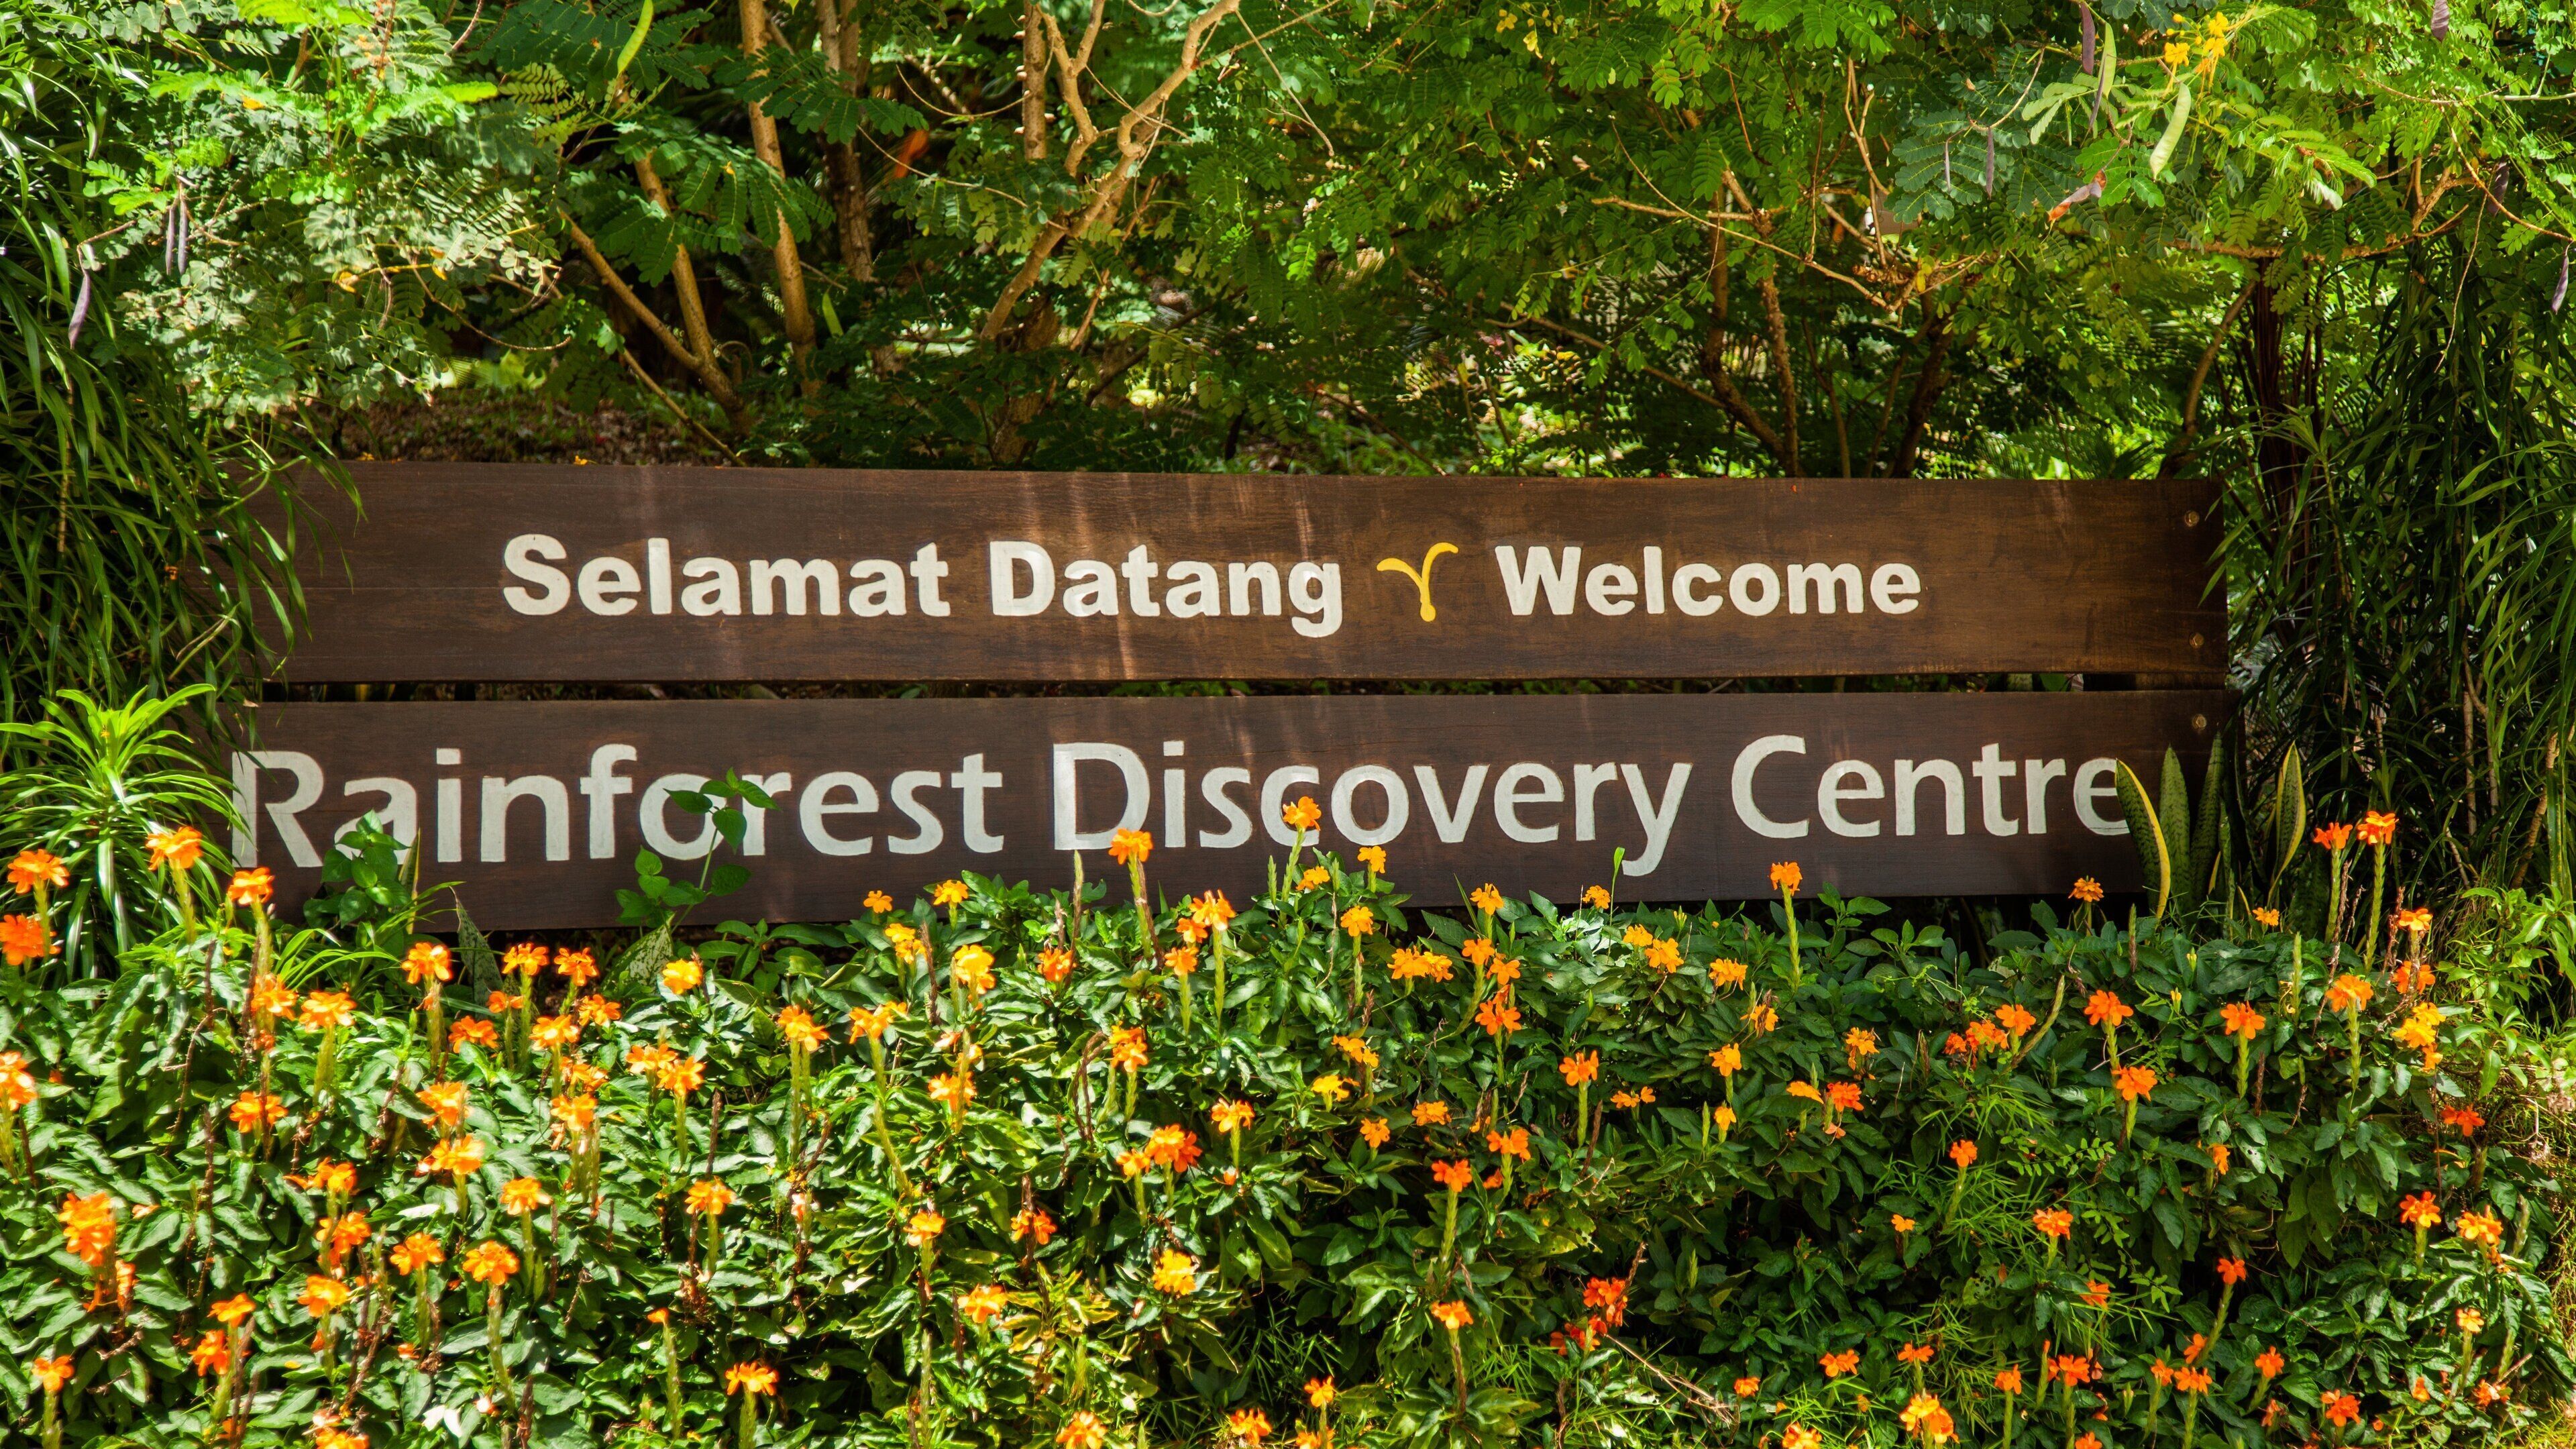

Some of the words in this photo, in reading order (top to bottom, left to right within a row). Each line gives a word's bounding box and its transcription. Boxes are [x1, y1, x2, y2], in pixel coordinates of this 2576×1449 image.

[503, 534, 950, 616] Selamat
[989, 541, 1342, 637] Datang
[1495, 545, 1921, 616] Welcome
[232, 743, 1004, 868] Rainforest
[1053, 740, 1693, 877] Discovery
[1731, 735, 2129, 838] Centre
